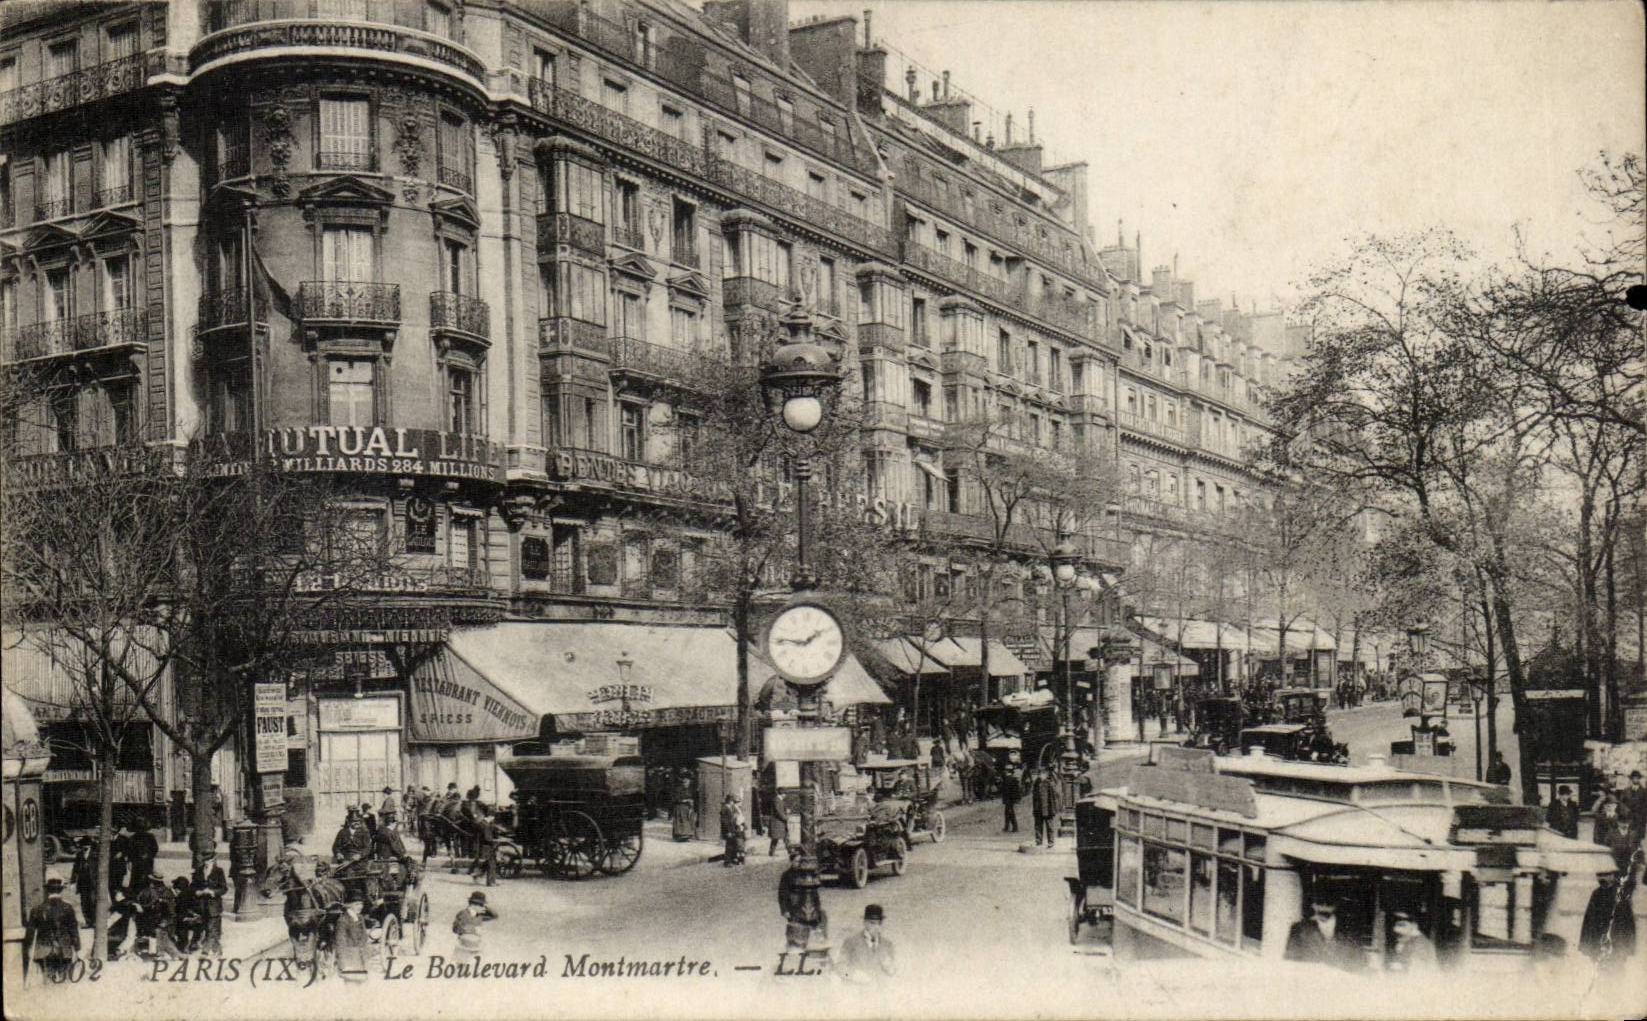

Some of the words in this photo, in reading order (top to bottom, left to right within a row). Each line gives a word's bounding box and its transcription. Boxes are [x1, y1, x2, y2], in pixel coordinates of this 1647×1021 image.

[439, 431, 500, 467] LIFE
[281, 457, 387, 473] MILLIARDS
[392, 459, 423, 473] 284
[429, 460, 495, 480] MILLIONS
[415, 677, 480, 706] RESTAURANT
[256, 716, 284, 734] FAUST
